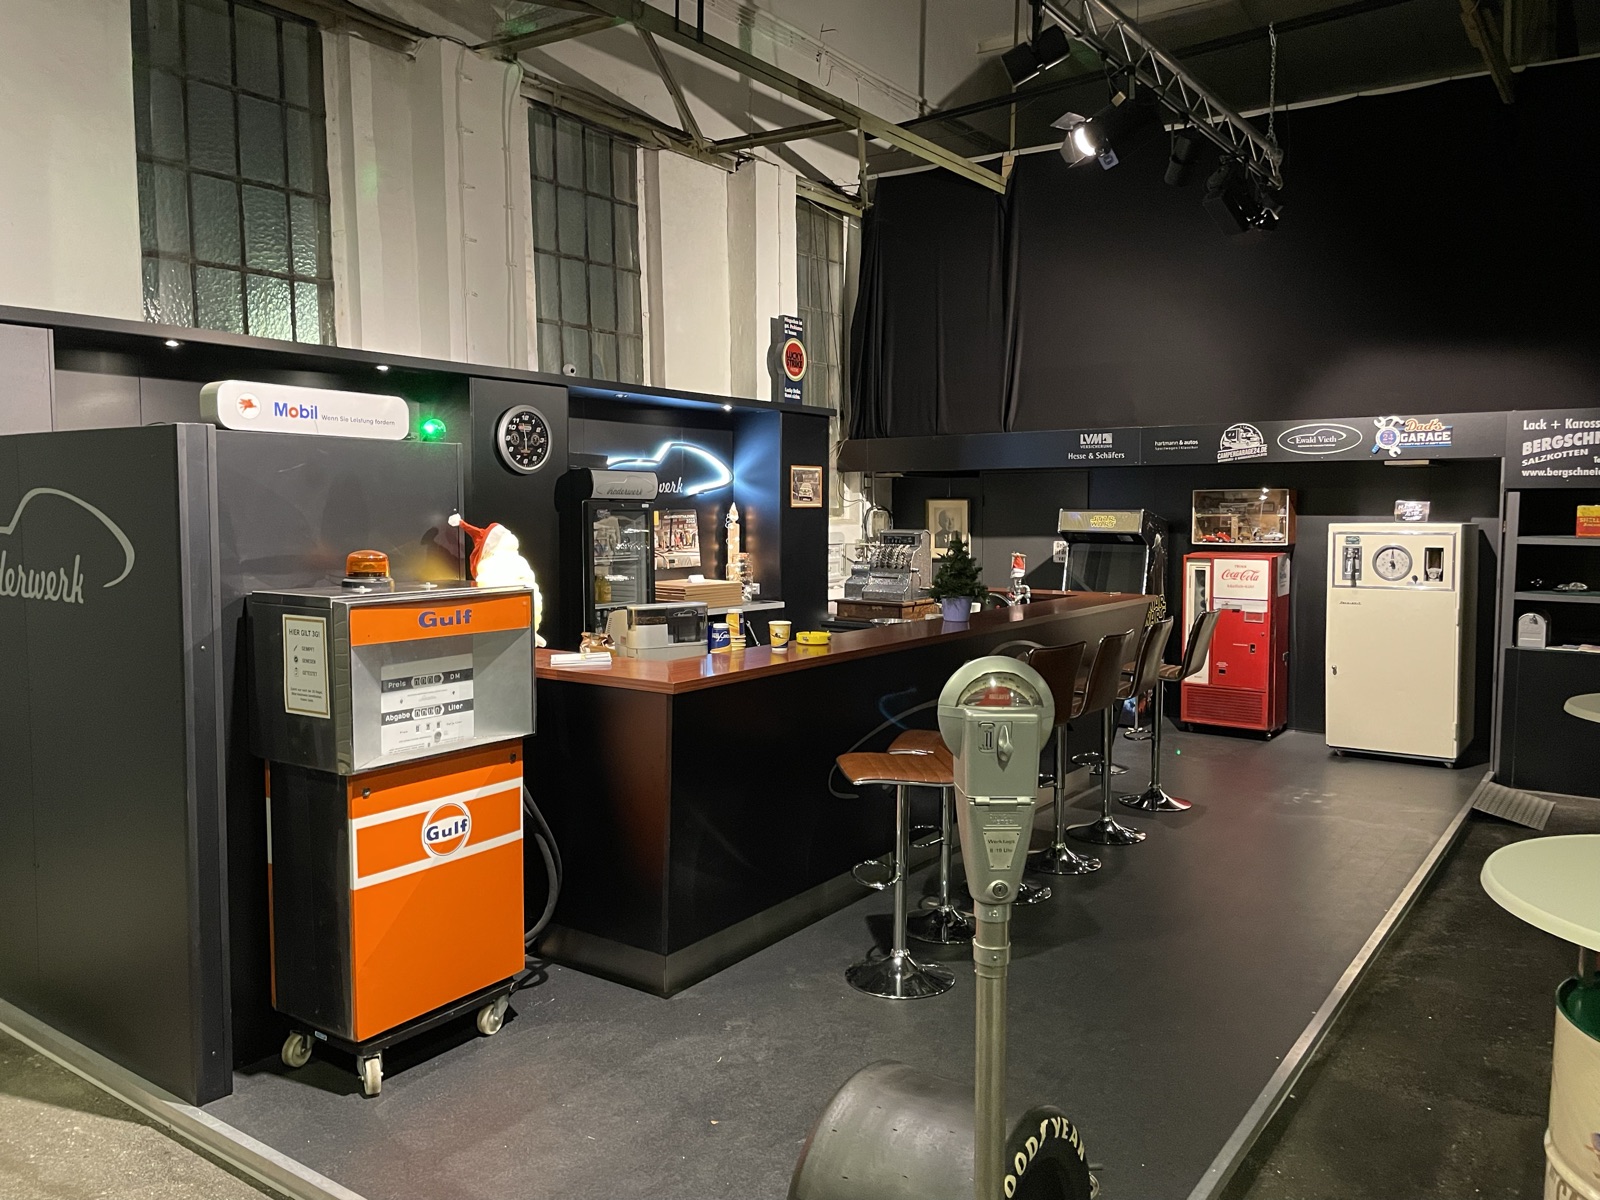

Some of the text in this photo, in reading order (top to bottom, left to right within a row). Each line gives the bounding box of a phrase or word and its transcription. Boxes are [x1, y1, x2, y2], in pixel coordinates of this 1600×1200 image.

[274, 402, 318, 420] Mobil
[350, 417, 373, 425] Leistung
[1405, 418, 1443, 432] Dad's
[1523, 419, 1547, 430] Lack
[1551, 420, 1561, 429] +
[1080, 433, 1102, 444] LVM
[1295, 436, 1316, 444] Ewald
[1382, 431, 1451, 443] 24 GARAGE
[1068, 451, 1125, 460] Hesse & Schäfers
[1522, 448, 1589, 467] SALZKOTTEN
[418, 608, 472, 629] Gulf
[289, 628, 300, 636] HIER
[301, 629, 311, 637] GILT
[385, 703, 463, 722] Abgabe Liter
[426, 819, 467, 841] Gulf
[1004, 1116, 1085, 1199] OODYEAR
